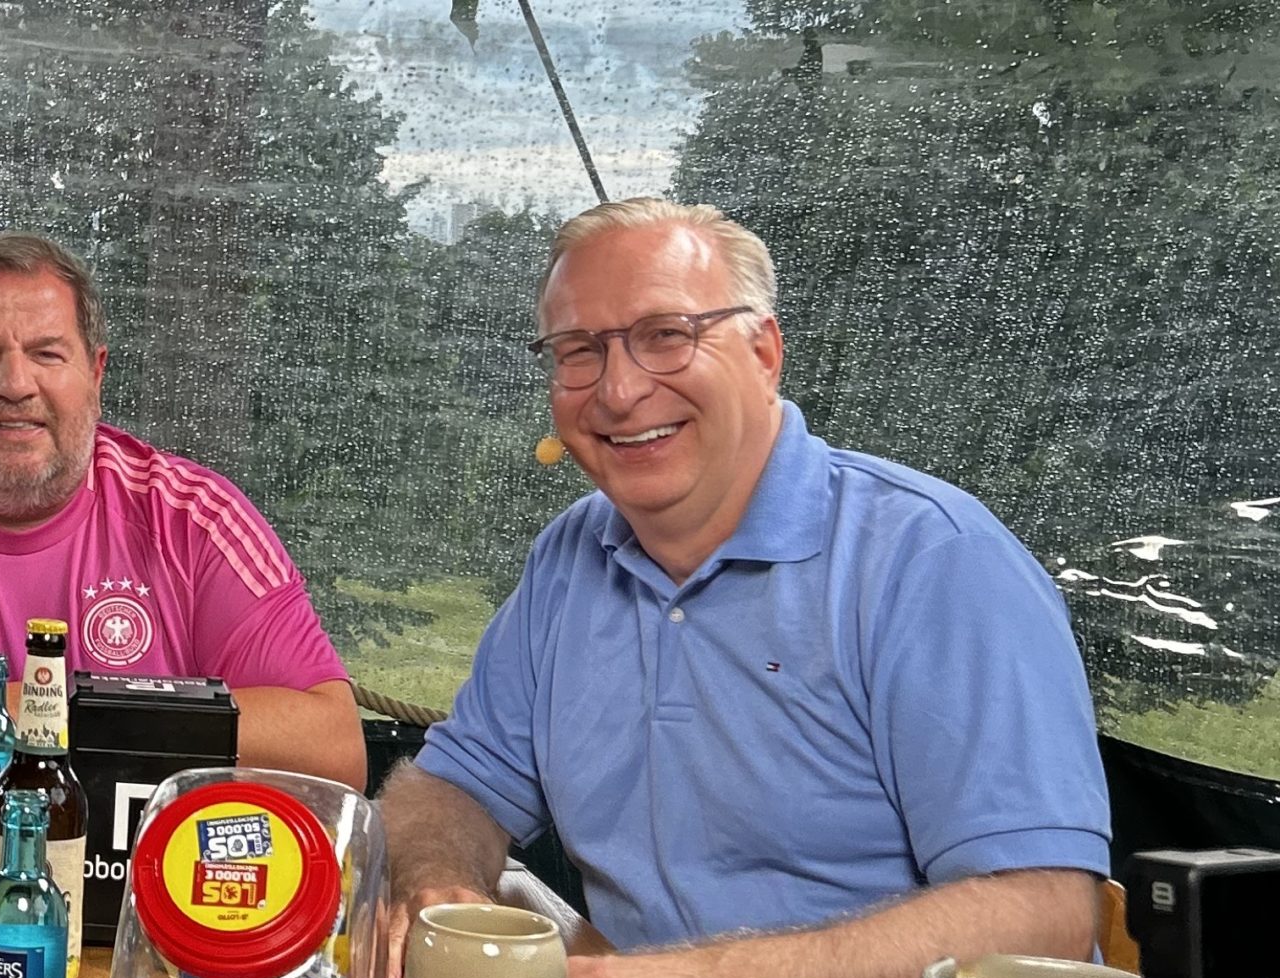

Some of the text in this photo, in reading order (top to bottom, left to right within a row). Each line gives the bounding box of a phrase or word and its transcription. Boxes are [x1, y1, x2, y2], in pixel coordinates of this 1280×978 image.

[23, 682, 63, 697] BINDING
[24, 699, 58, 713] Radler
[216, 822, 260, 836] 50.000
[208, 833, 263, 859] LOS
[215, 870, 257, 882] 10.000
[202, 881, 257, 906] LOS
[1151, 881, 1176, 905] 8
